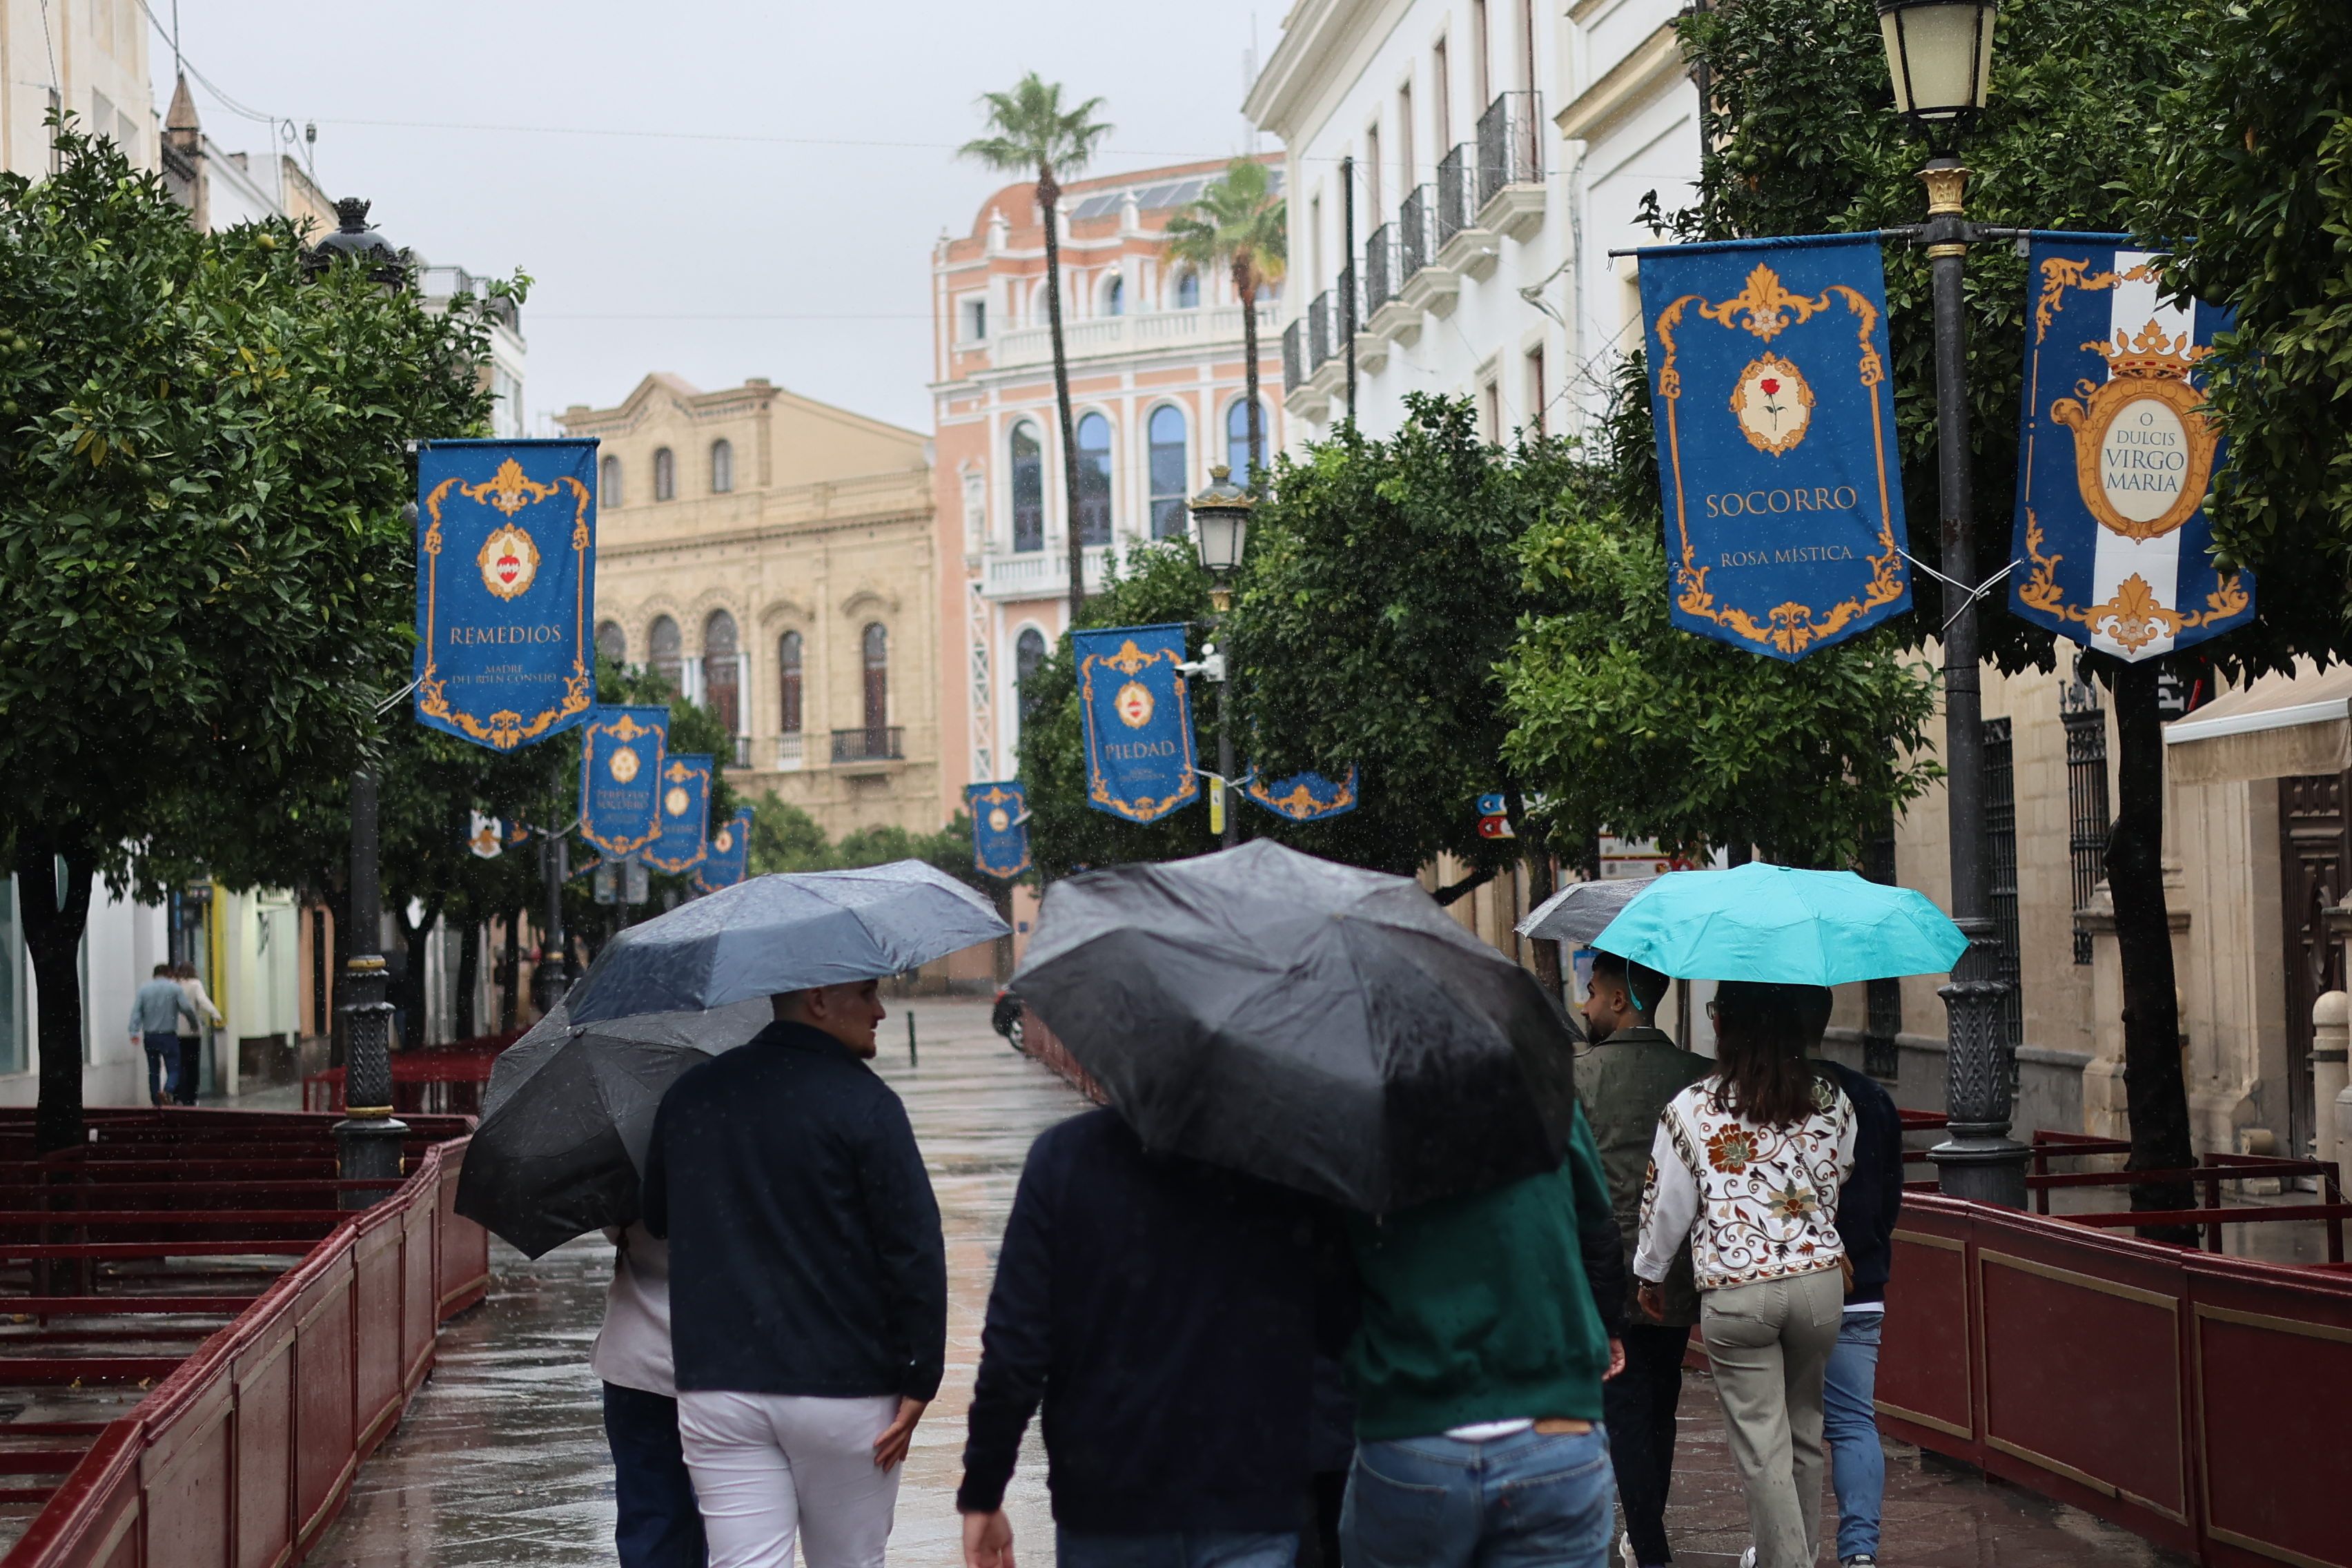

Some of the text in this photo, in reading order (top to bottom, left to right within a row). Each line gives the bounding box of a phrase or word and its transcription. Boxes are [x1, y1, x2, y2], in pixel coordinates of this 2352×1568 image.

[2140, 412, 2153, 427] O
[2117, 429, 2175, 447] DULCIS
[2106, 448, 2184, 471] VIRGO
[2106, 471, 2179, 492] MARIA
[1706, 485, 1857, 518] SOCORRO
[1721, 545, 1853, 567] ROSA MÍSTICA
[450, 625, 562, 645] REMEDIOS
[486, 665, 524, 674] MADRE
[1105, 740, 1176, 760] PIEDAD
